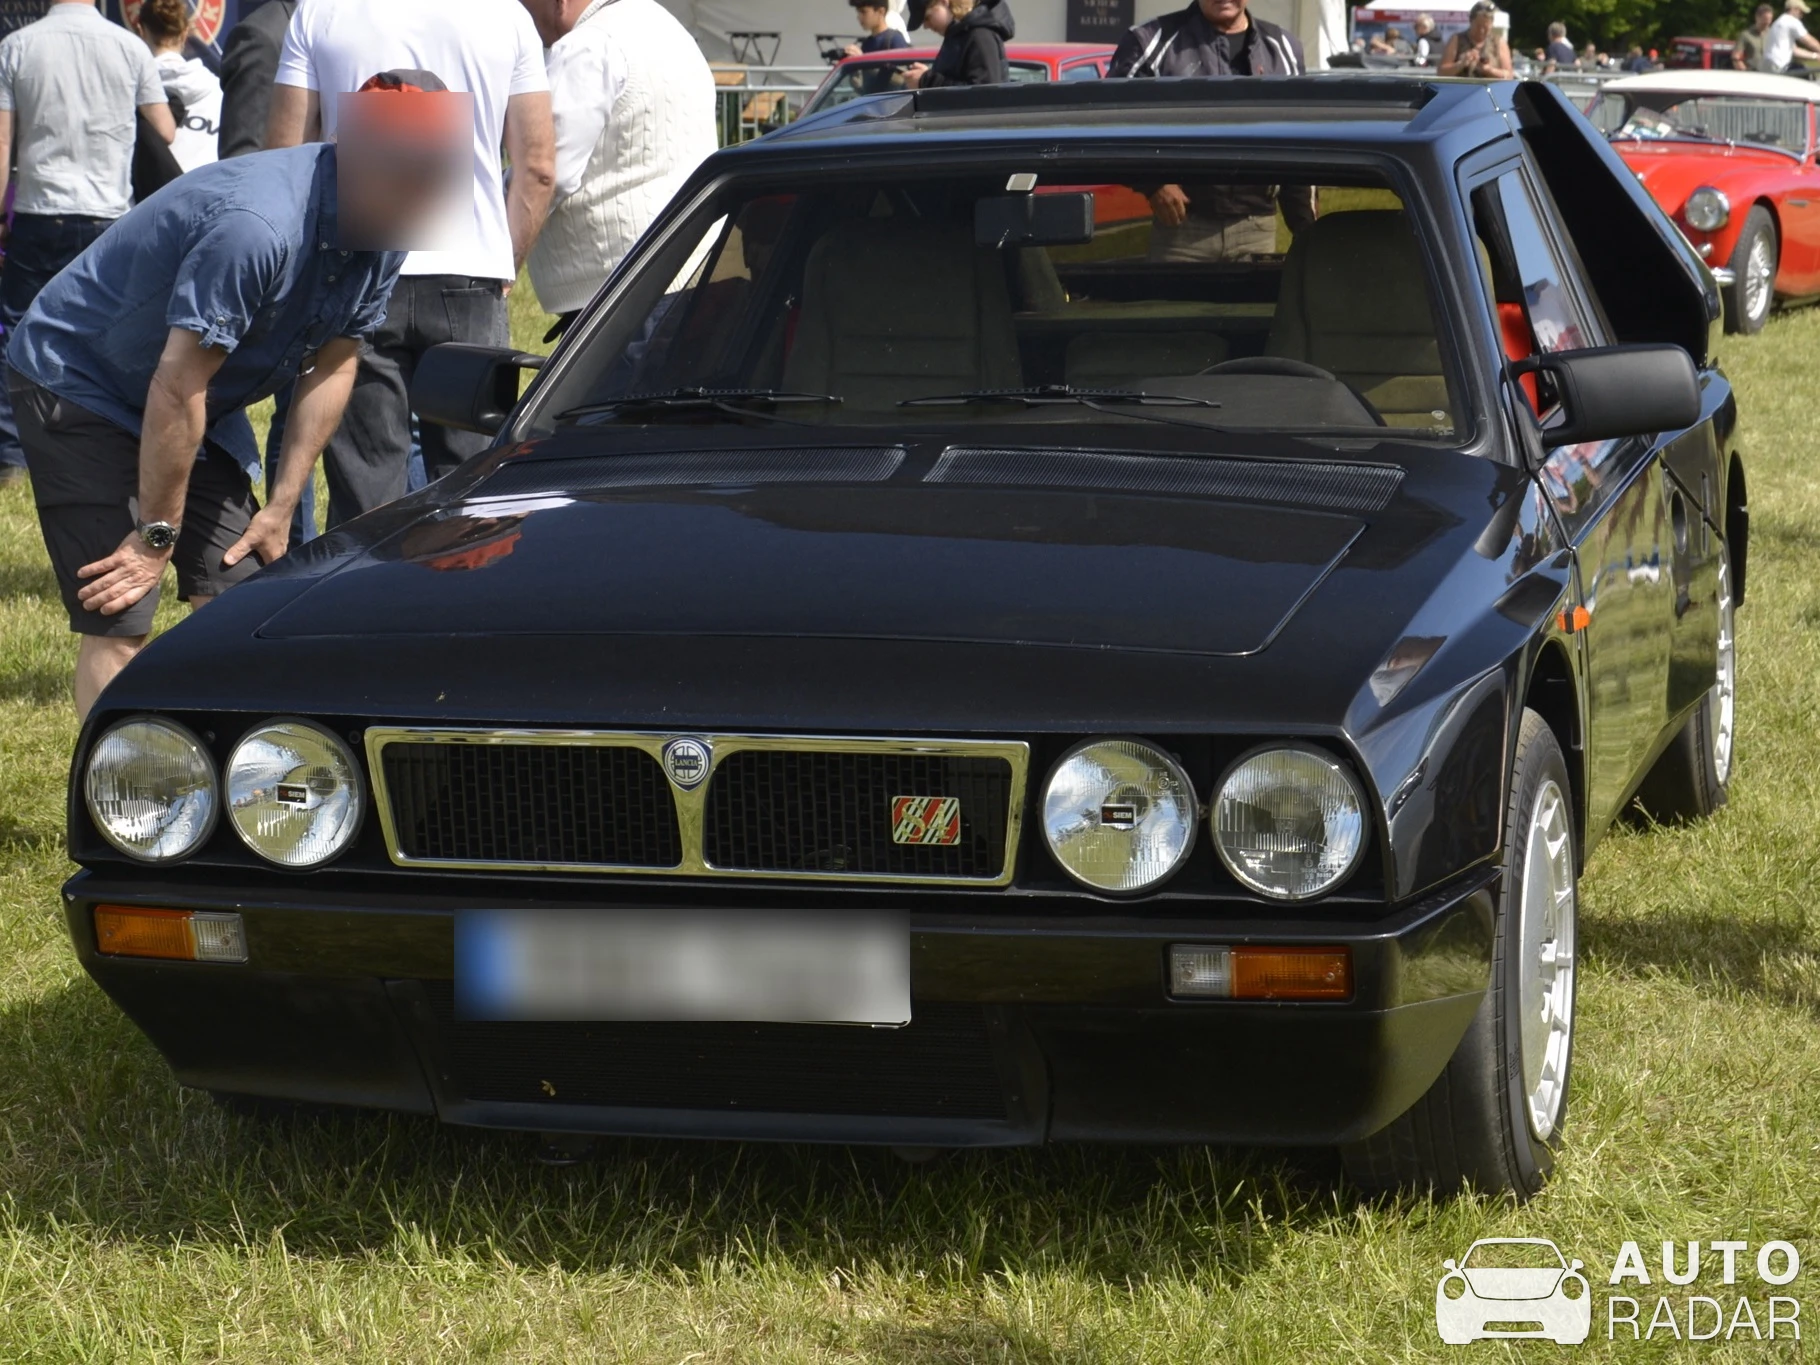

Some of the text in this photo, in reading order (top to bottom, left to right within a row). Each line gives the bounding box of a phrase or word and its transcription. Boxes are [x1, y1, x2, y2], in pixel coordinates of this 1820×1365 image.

[674, 758, 699, 767] LANCIA
[287, 790, 306, 799] SIEM
[1112, 811, 1133, 819] SIEM
[901, 801, 951, 840] S4
